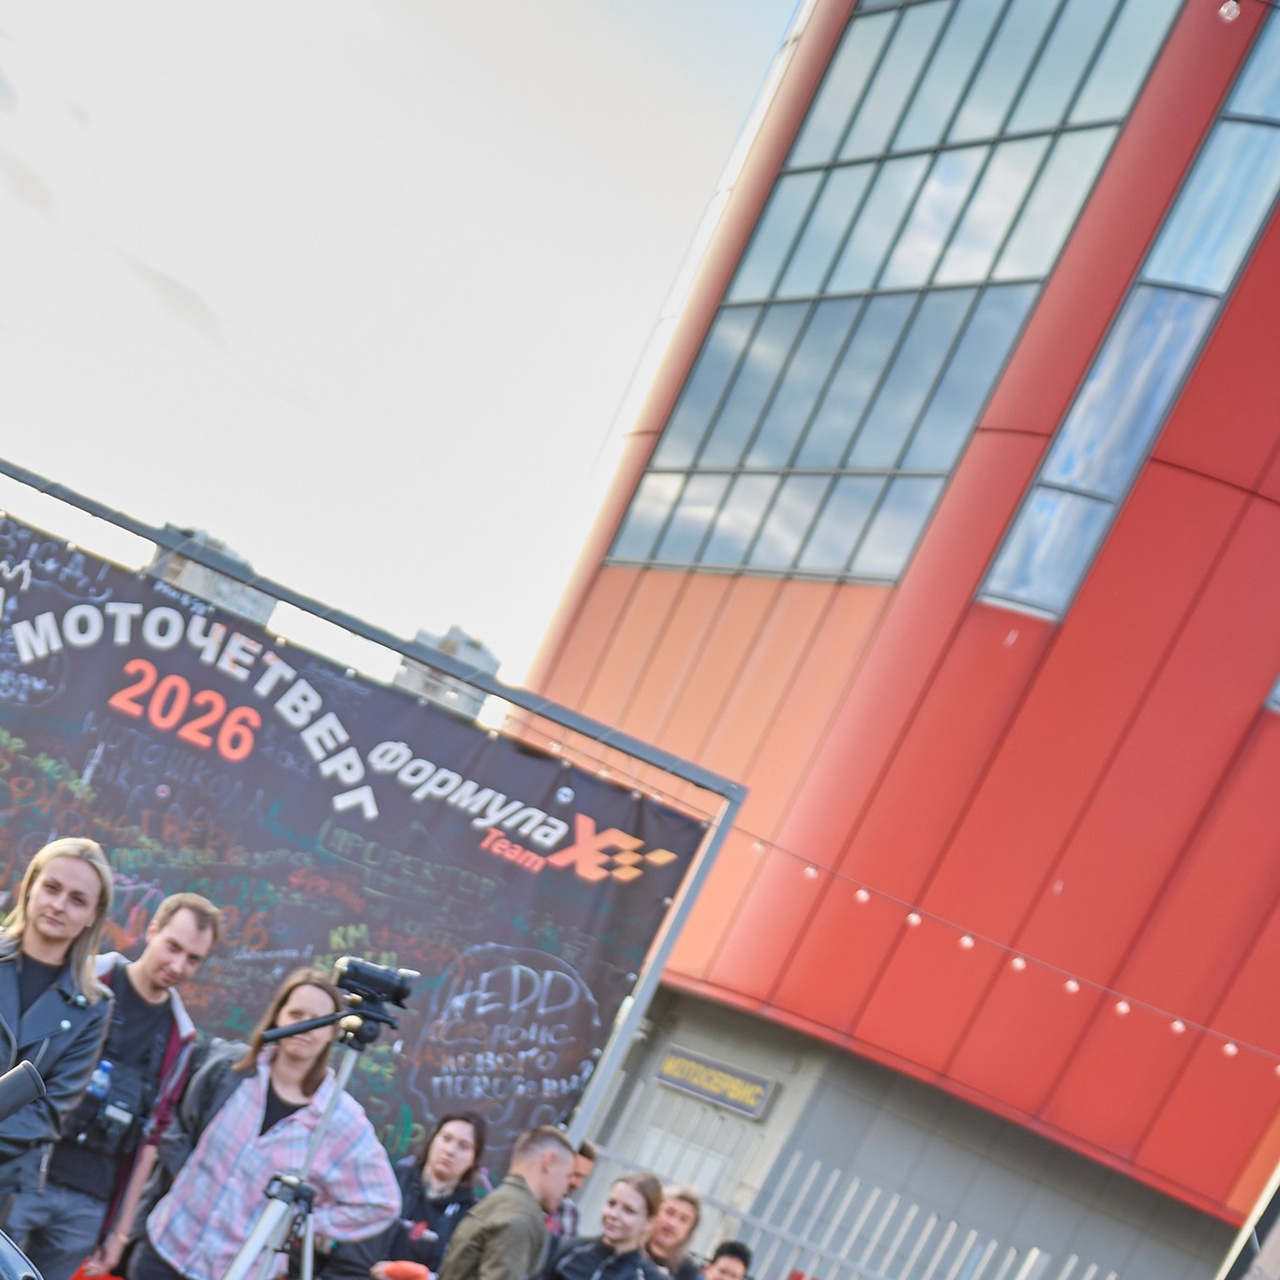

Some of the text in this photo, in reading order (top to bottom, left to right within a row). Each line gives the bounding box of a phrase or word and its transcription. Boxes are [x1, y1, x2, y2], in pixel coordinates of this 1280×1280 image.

[11, 601, 380, 820] МОТОЧЕТВЕРГ
[108, 657, 263, 762] 2026
[367, 740, 570, 848] Формула
[479, 827, 548, 874] Team
